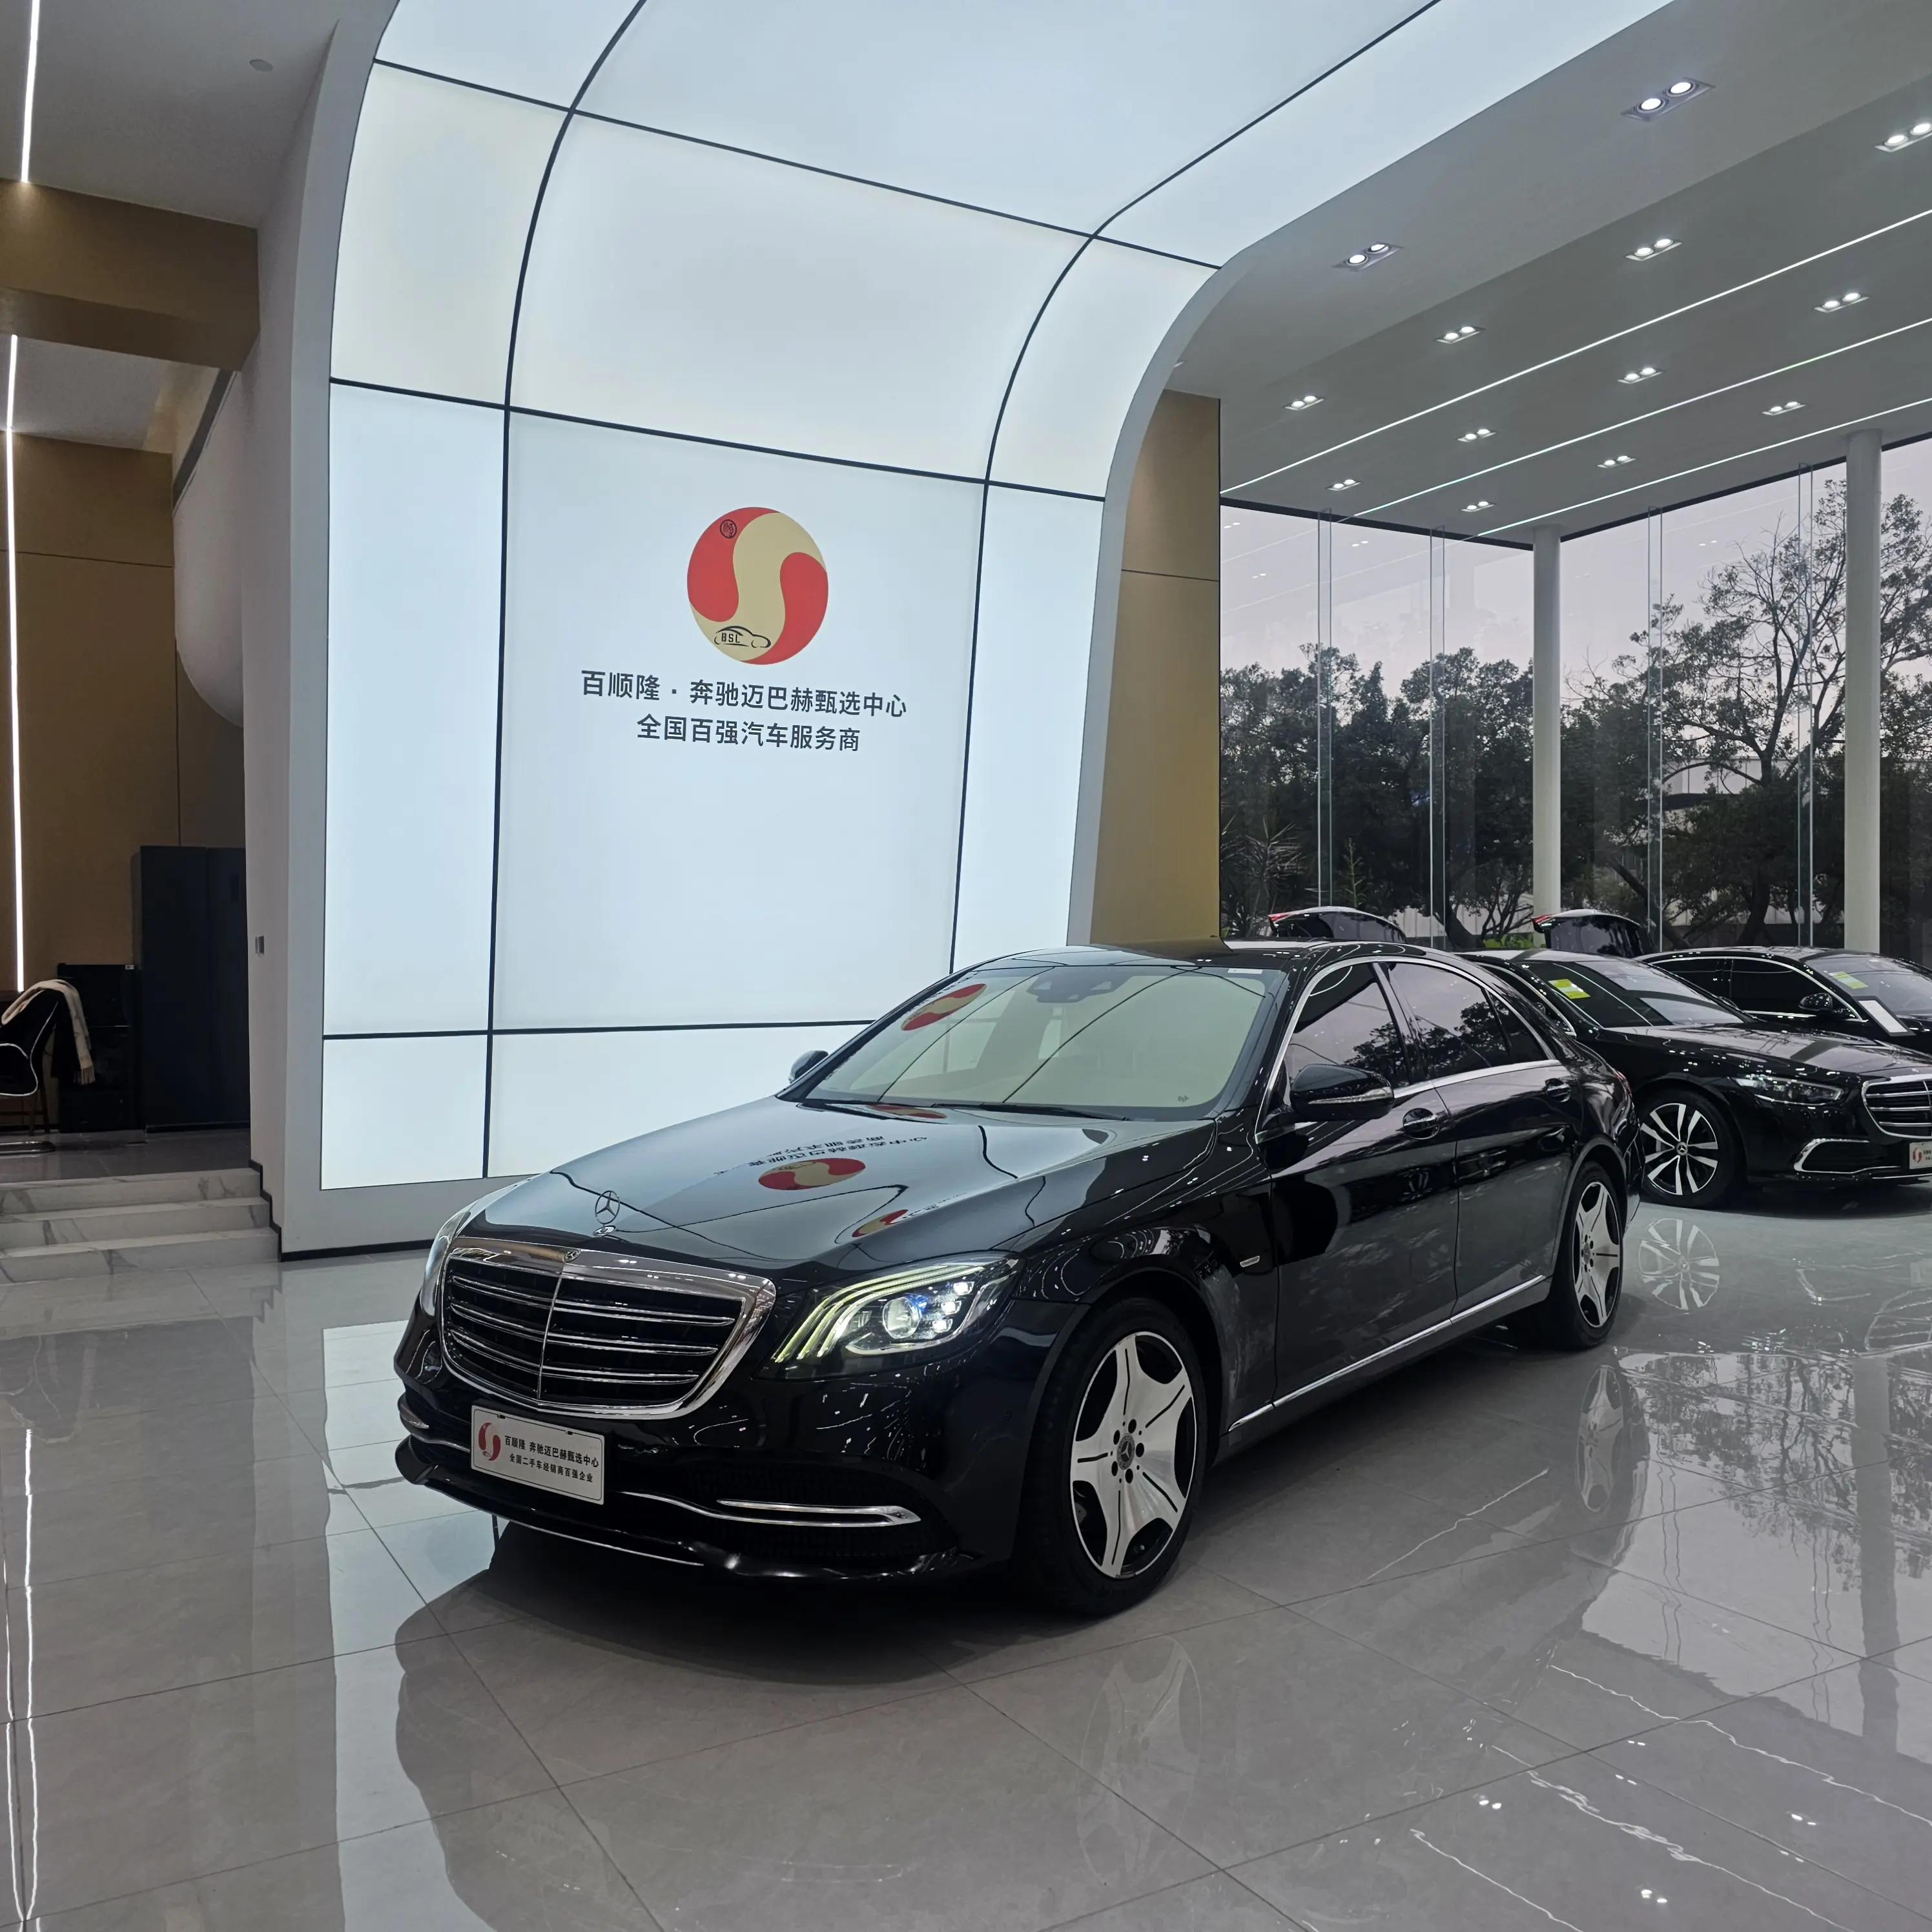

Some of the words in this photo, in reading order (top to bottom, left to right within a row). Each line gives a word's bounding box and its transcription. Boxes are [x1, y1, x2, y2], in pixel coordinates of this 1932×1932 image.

[721, 632, 740, 644] BSL
[637, 713, 860, 752] 全国百强汽车服务商
[504, 1435, 526, 1450] 百顺隆
[529, 1441, 599, 1468] 奔驰迈巴赫甄选中心
[509, 1453, 593, 1483] 全国二手车经销商百强企业
